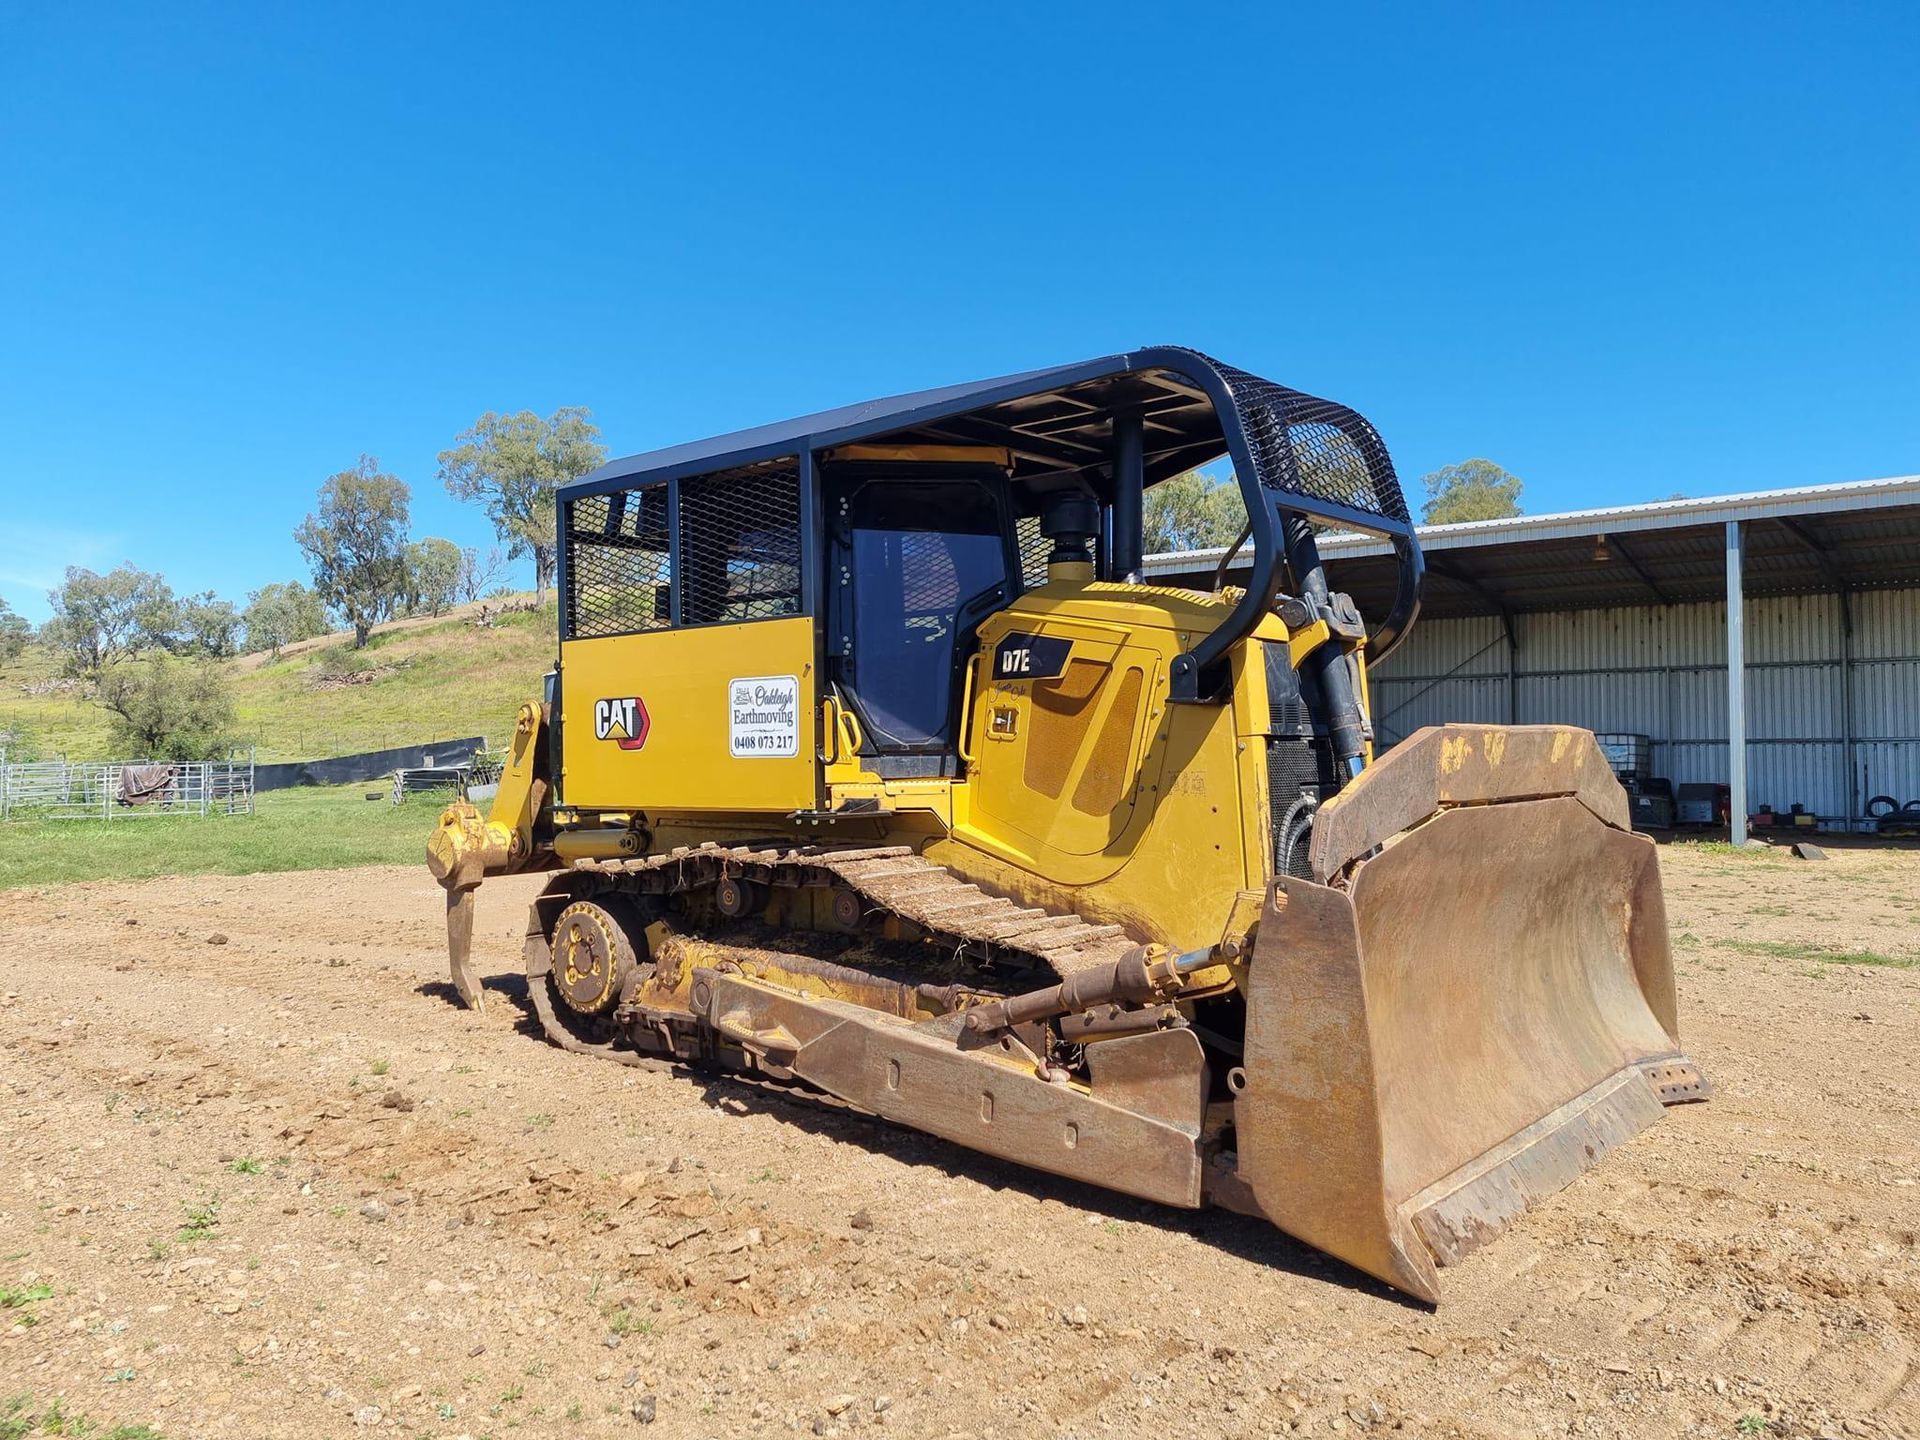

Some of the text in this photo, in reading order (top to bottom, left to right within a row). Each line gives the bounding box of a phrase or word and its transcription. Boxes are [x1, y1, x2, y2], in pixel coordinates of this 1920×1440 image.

[1002, 648, 1030, 673] D7E
[754, 685, 794, 711] Oakleigh
[595, 699, 636, 739] CAT
[734, 708, 794, 727] Earthmoving
[734, 735, 793, 749] 0408 073 217
